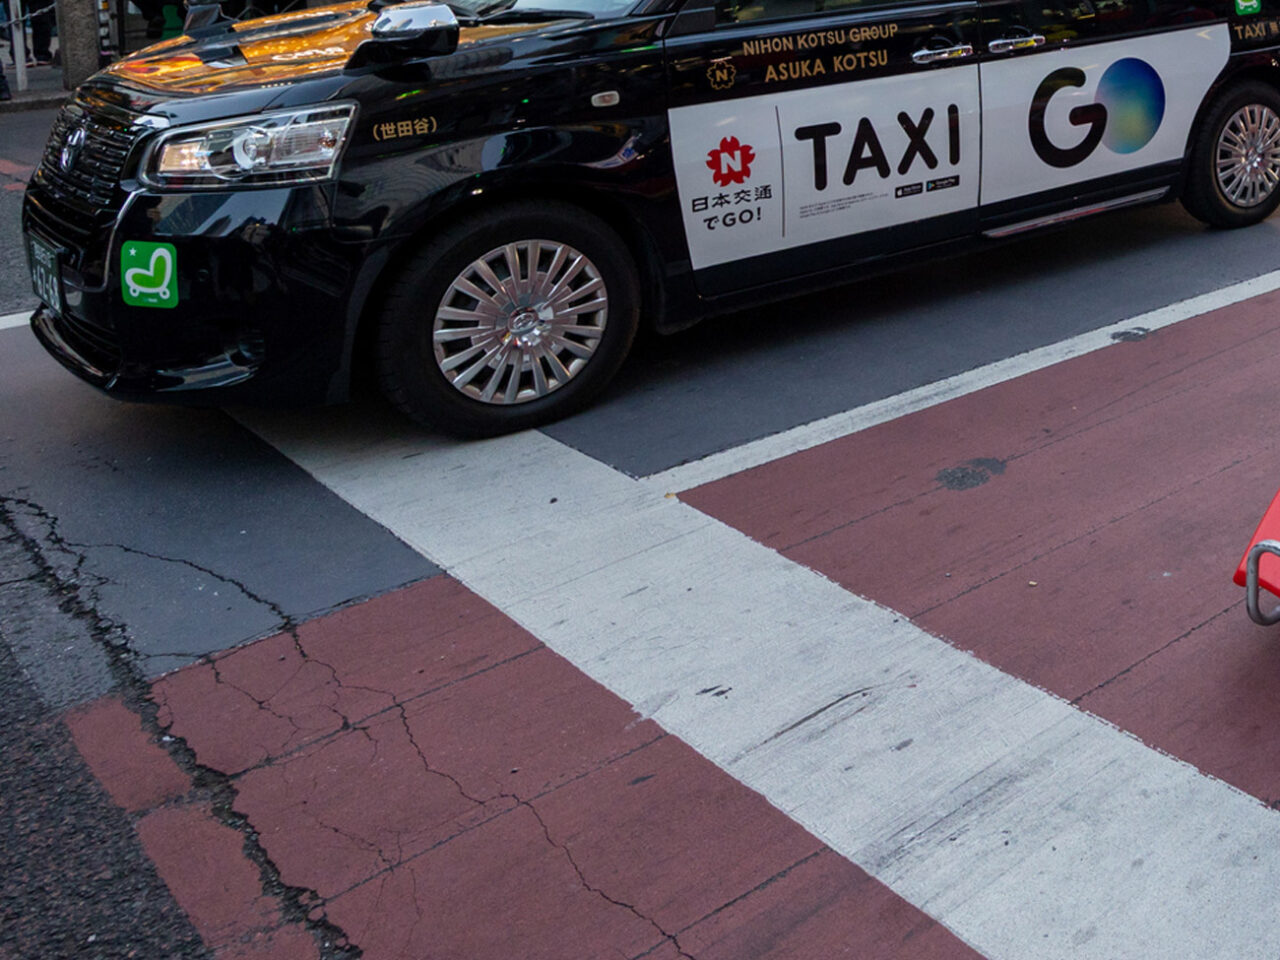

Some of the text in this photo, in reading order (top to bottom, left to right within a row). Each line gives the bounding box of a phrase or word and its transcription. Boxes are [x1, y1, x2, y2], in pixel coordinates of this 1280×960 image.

[742, 23, 898, 57] NIHON KOTSU GROUP
[1234, 22, 1266, 41] TAXI
[764, 49, 888, 83] ASUKA KOTSU
[794, 103, 961, 192] TAXI
[691, 184, 773, 213] 日本交通
[703, 207, 763, 232] でGO!
